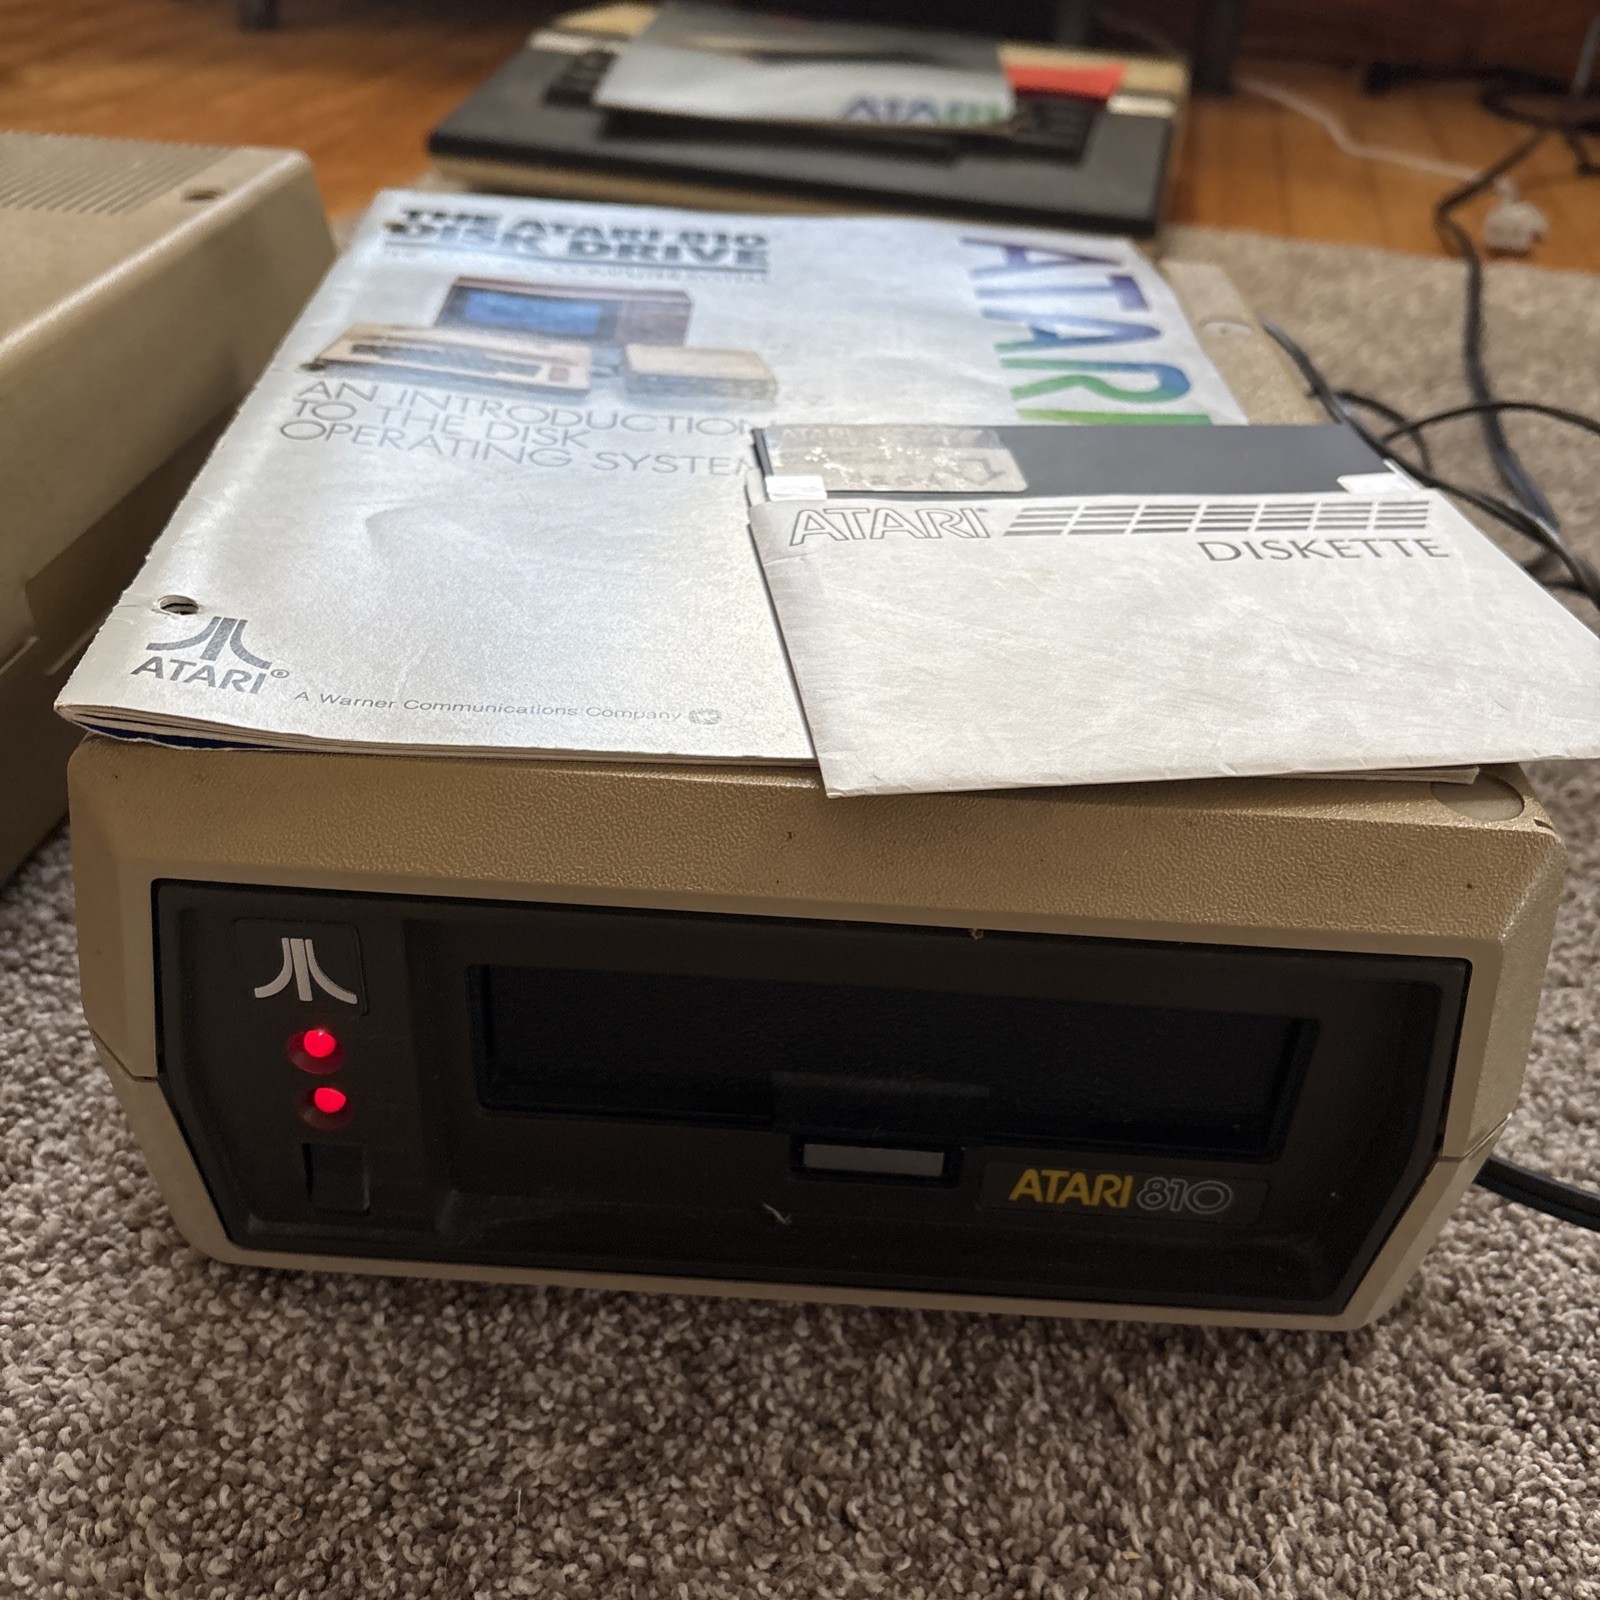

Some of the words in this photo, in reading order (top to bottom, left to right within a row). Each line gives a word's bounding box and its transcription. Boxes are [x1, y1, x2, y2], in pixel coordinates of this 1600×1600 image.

[512, 217, 662, 243] ATARI
[568, 238, 767, 267] DRIVE
[958, 236, 1214, 426] ATARI
[297, 380, 378, 402] AN
[293, 398, 357, 421] TO
[376, 403, 466, 432] THE
[486, 419, 591, 448] DISK
[280, 419, 574, 468] OPERATING
[789, 507, 991, 547] ATARI
[1197, 538, 1450, 562] DISKETTE
[293, 691, 310, 702] A
[319, 693, 397, 709] Warner
[403, 699, 579, 717] Communications
[585, 706, 682, 722] Company
[1009, 1168, 1134, 1209] ATARI
[1136, 1176, 1234, 1215] 810
